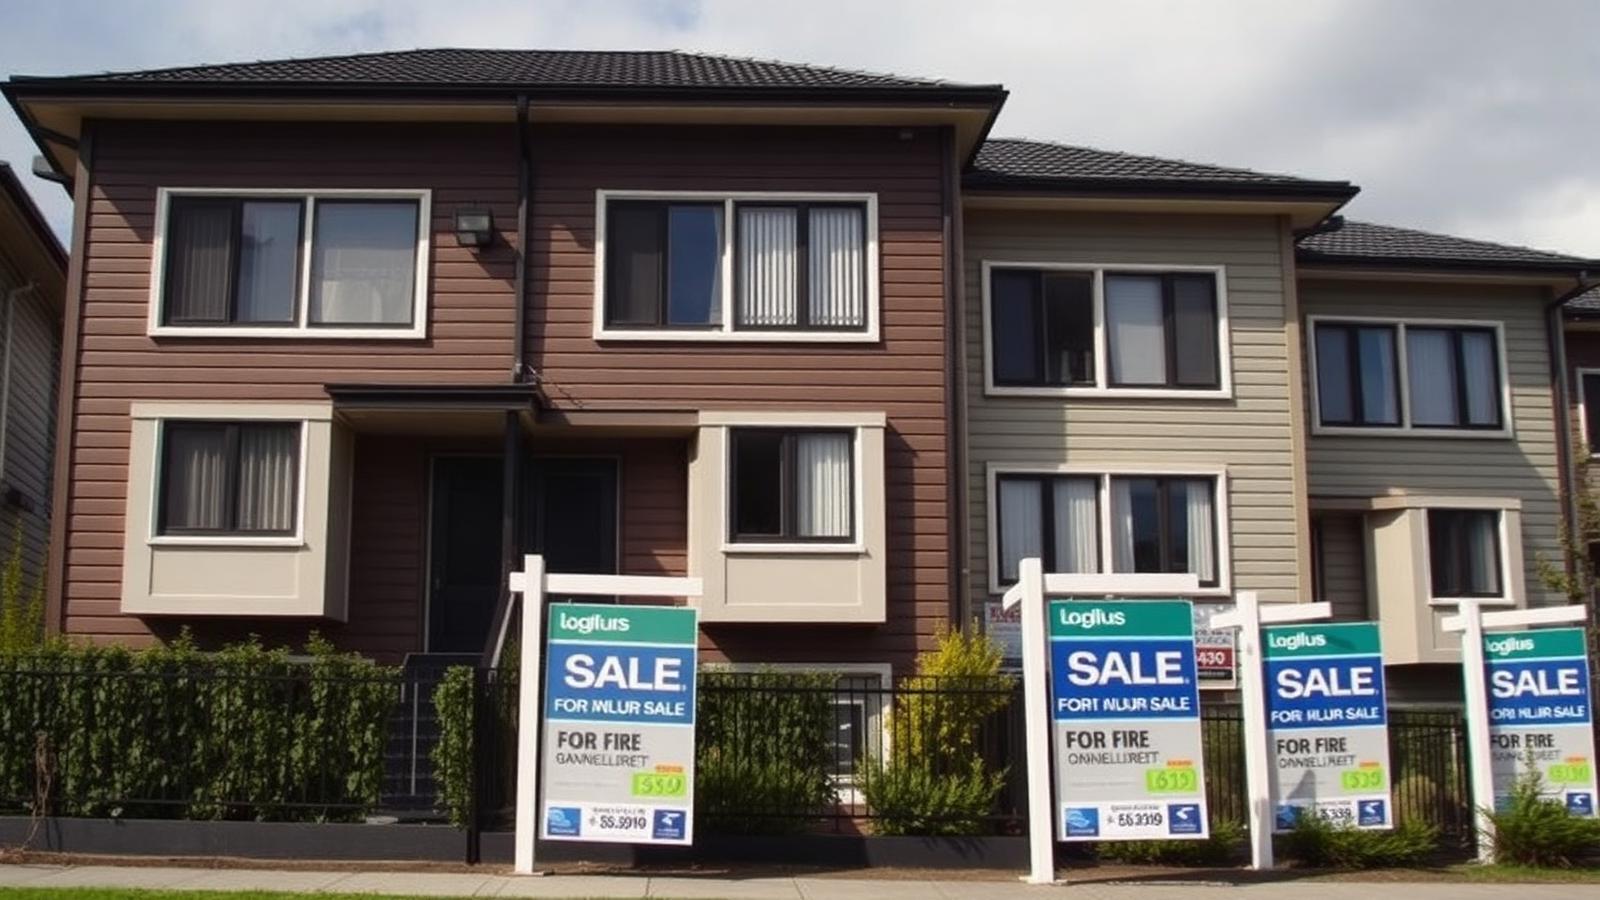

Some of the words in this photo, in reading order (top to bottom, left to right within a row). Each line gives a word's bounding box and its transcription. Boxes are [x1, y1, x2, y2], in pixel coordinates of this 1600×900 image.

[554, 699, 587, 713] FOR
[643, 701, 685, 716] SALE
[1150, 696, 1190, 711] SALE
[1553, 705, 1585, 718] SALE
[1345, 706, 1379, 720] SALE
[557, 731, 597, 749] FOR
[603, 733, 641, 751] FIRE
[1066, 730, 1106, 749] FOR
[1113, 730, 1150, 748] FIRE
[1277, 739, 1310, 754] FOR
[1315, 737, 1347, 753] FIRE
